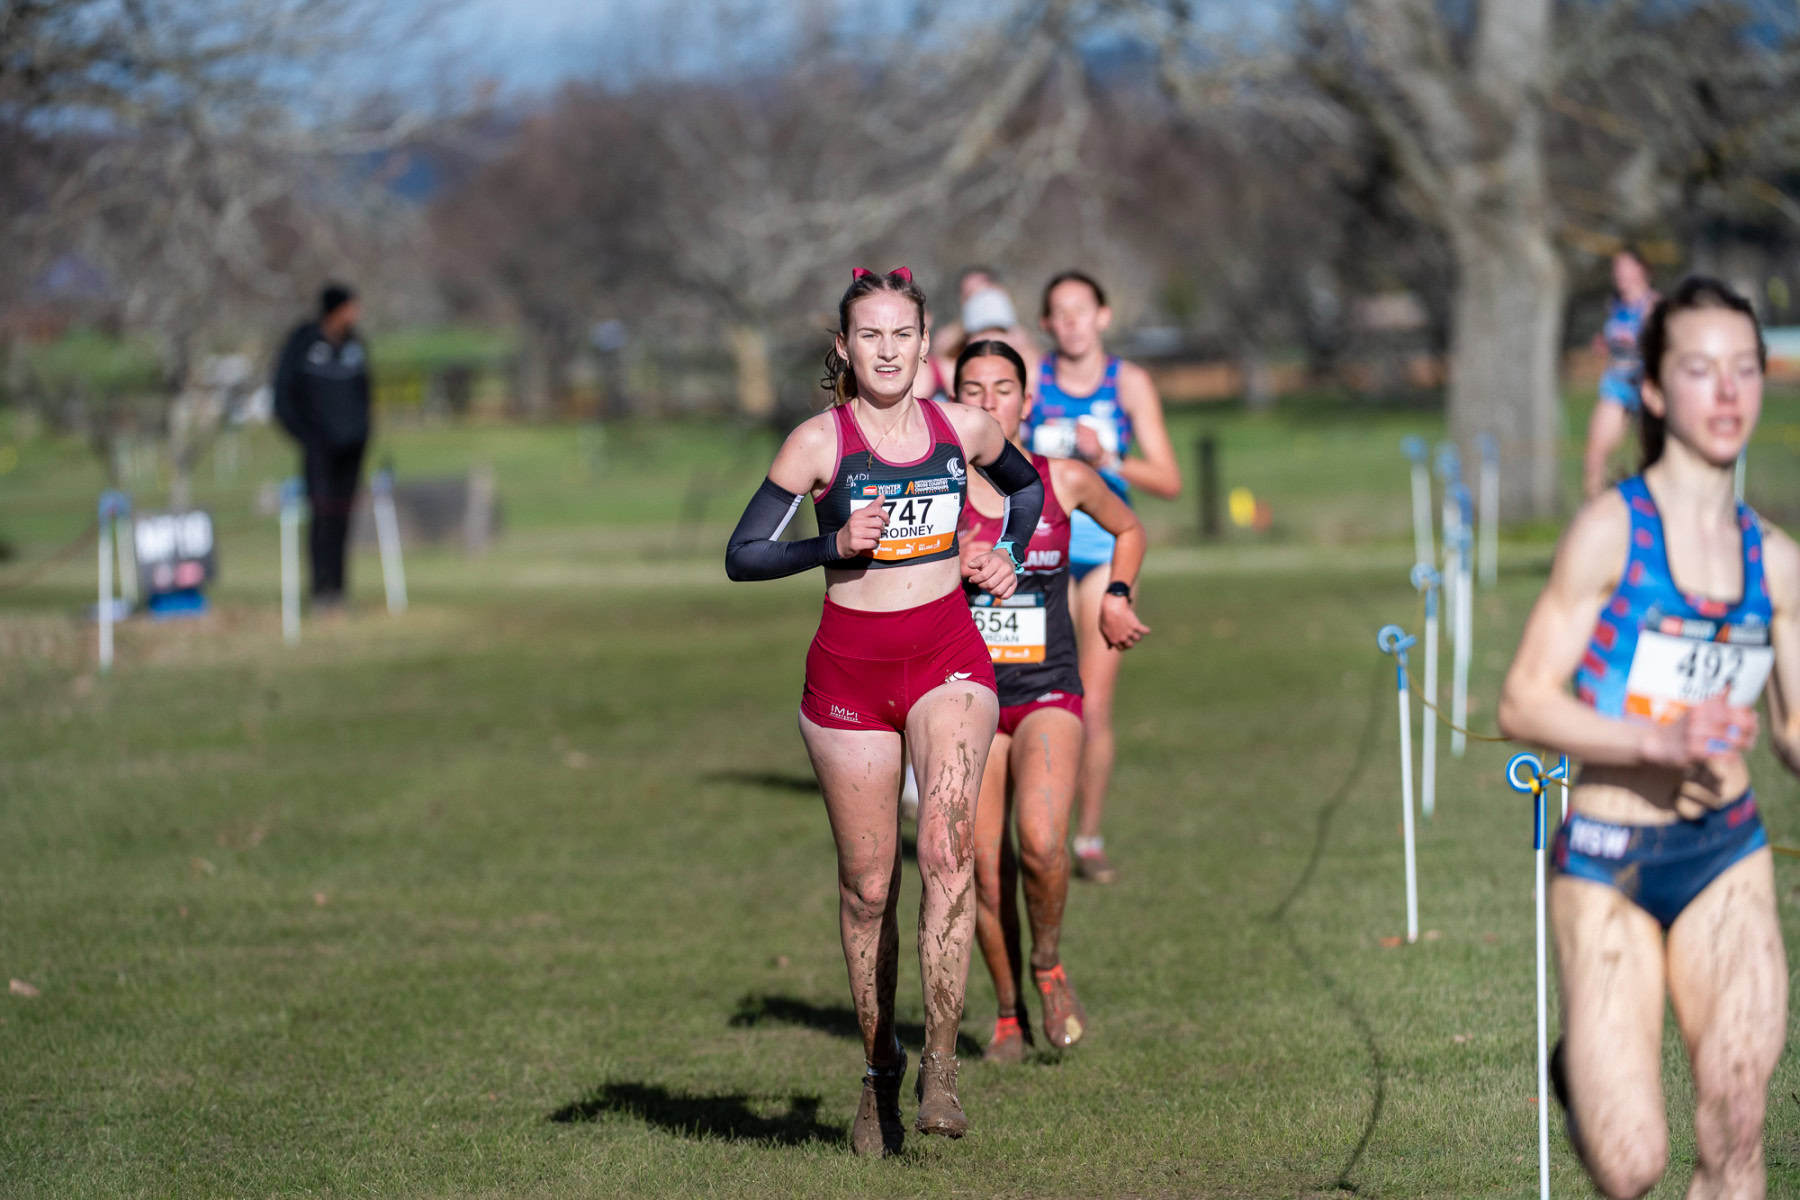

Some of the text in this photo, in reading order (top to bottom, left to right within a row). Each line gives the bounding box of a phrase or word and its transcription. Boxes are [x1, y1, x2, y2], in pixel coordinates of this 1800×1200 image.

[878, 483, 902, 492] WINTER
[880, 498, 933, 527] 747
[880, 524, 934, 539] RODNEY
[973, 610, 1019, 633] 654
[1676, 644, 1745, 683] 492
